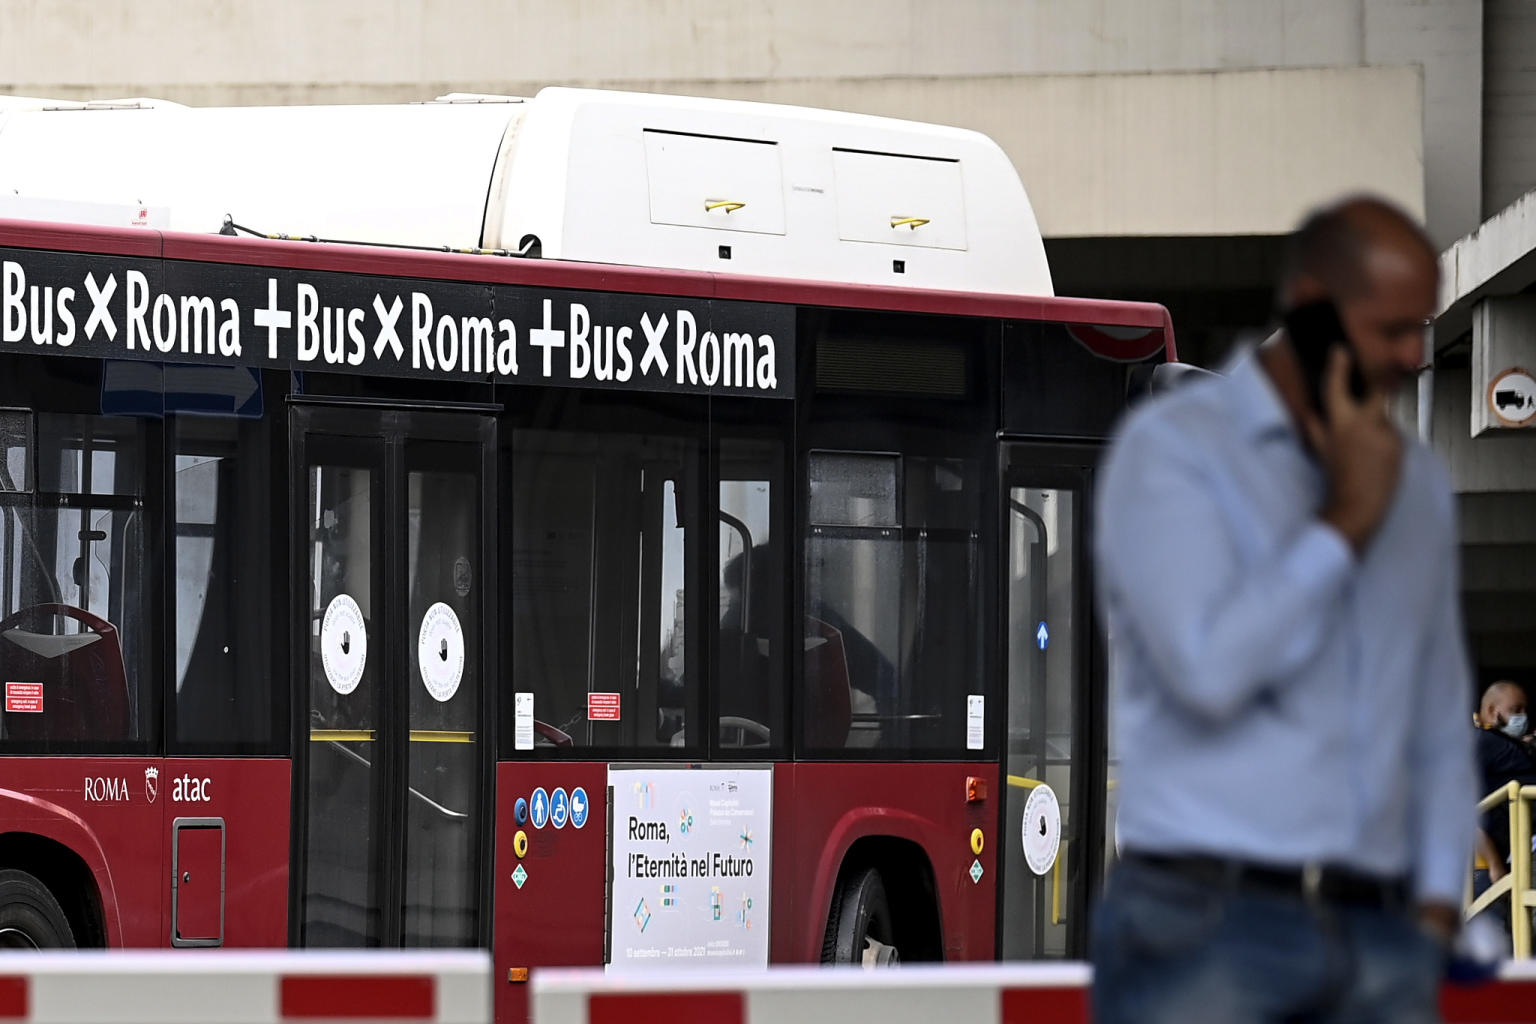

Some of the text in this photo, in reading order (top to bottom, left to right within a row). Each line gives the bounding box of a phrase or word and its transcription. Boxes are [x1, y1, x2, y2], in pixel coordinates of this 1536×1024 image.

[84, 777, 130, 801] ROMA
[172, 773, 211, 802] atac
[628, 816, 670, 844] Roma,
[691, 852, 710, 877] nel
[713, 853, 754, 877] Futuro
